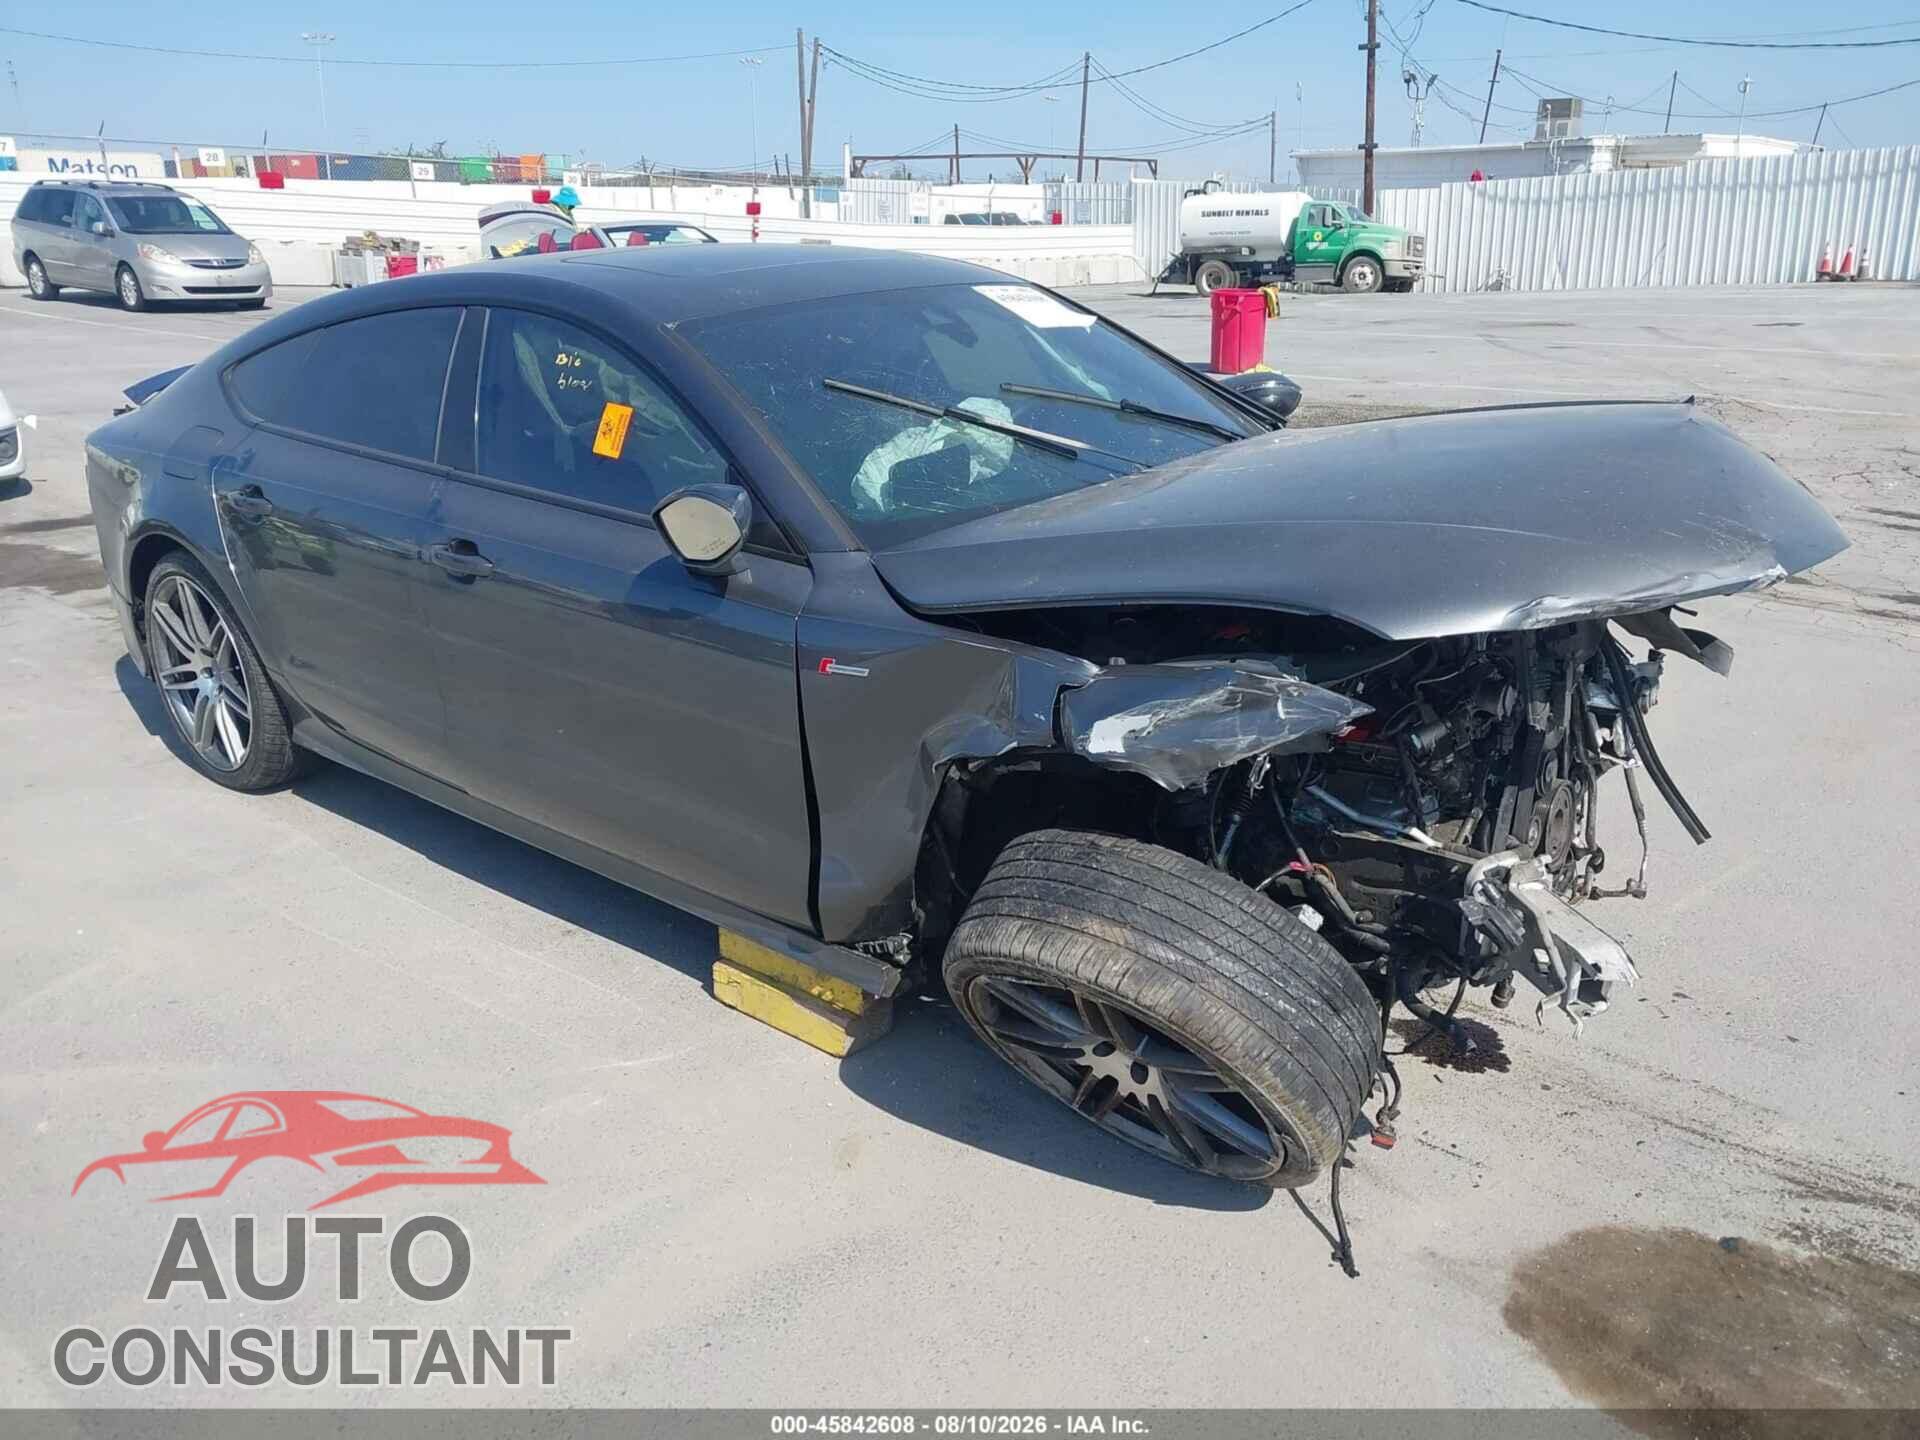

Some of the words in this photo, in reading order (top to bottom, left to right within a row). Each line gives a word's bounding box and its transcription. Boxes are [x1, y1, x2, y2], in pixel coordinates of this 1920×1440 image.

[205, 152, 219, 162] 28
[47, 157, 138, 178] Matson
[1201, 210, 1233, 218] SUNBELT
[1235, 209, 1270, 217] RENTALS
